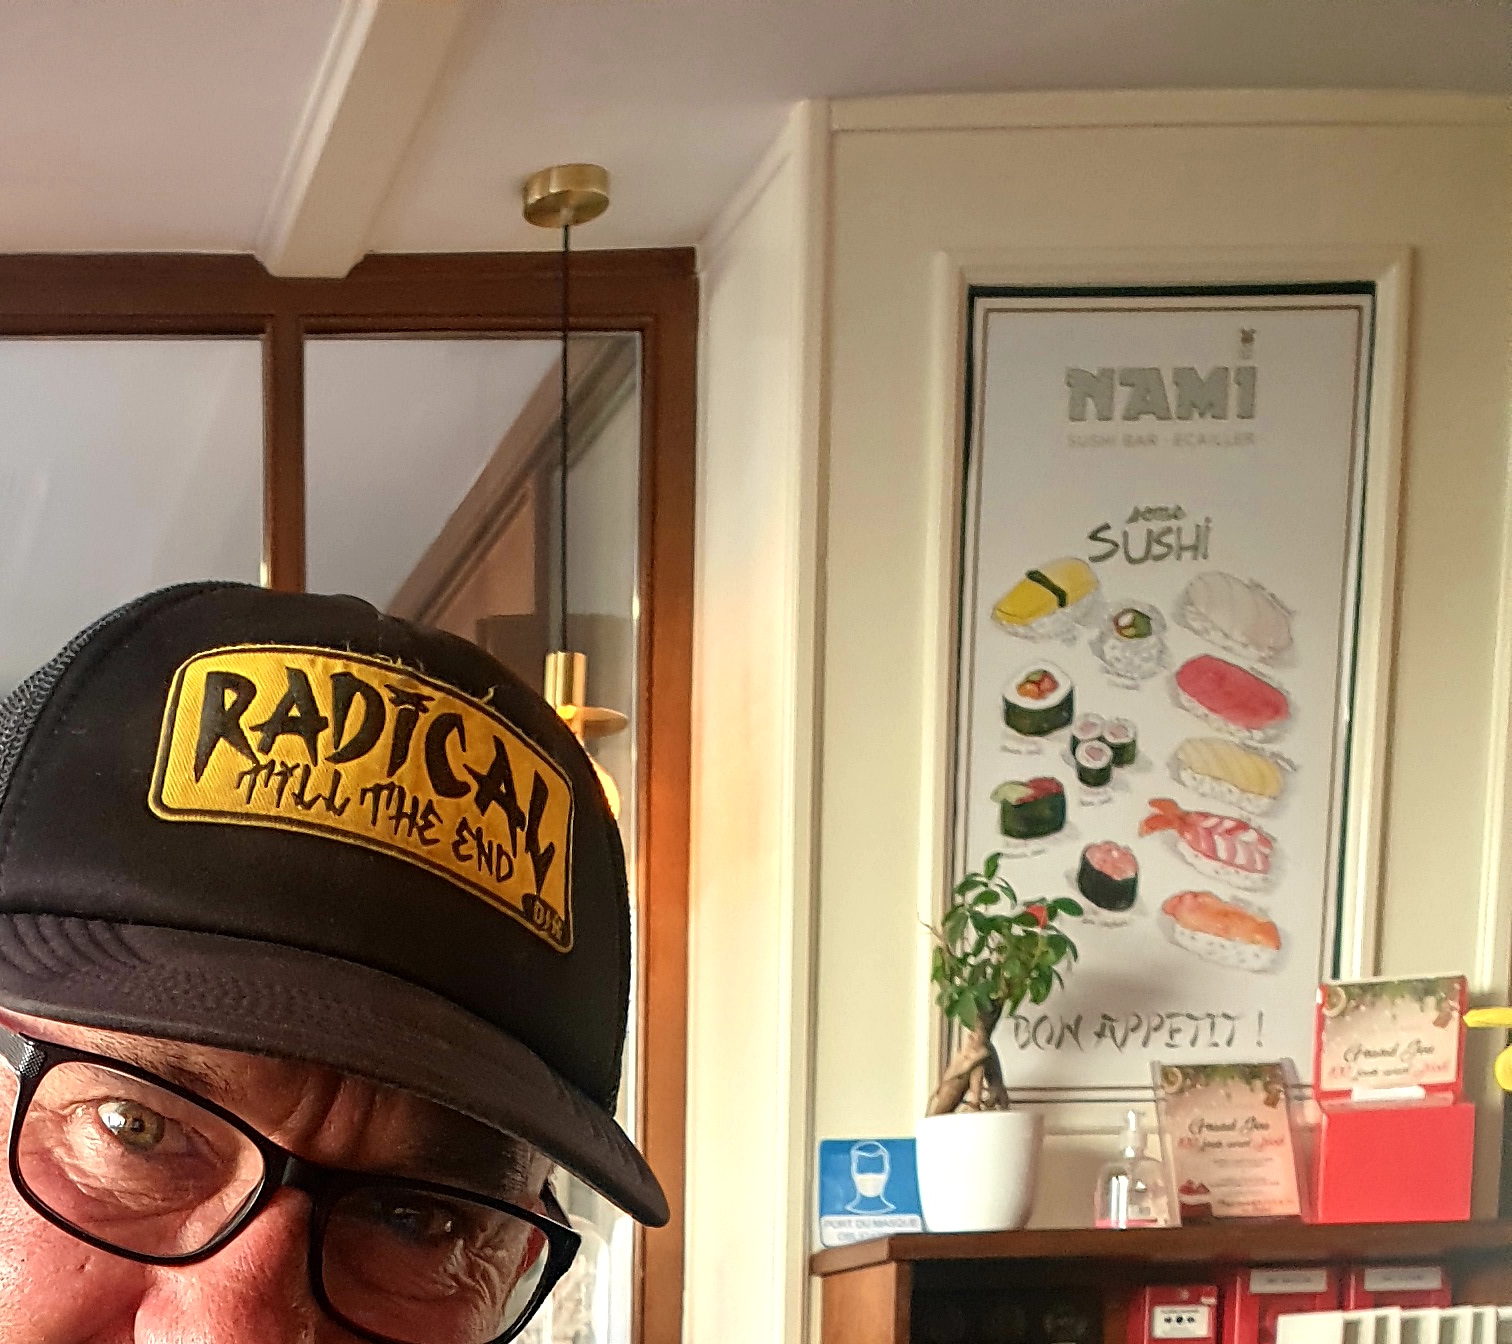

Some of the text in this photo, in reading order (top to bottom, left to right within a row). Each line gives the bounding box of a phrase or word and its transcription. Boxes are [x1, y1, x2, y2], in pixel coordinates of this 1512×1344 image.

[193, 666, 557, 896] RADICAL
[236, 759, 514, 883] TILL THE END
[1012, 1013, 1086, 1053] BON
[1092, 1011, 1242, 1054] APPETIT
